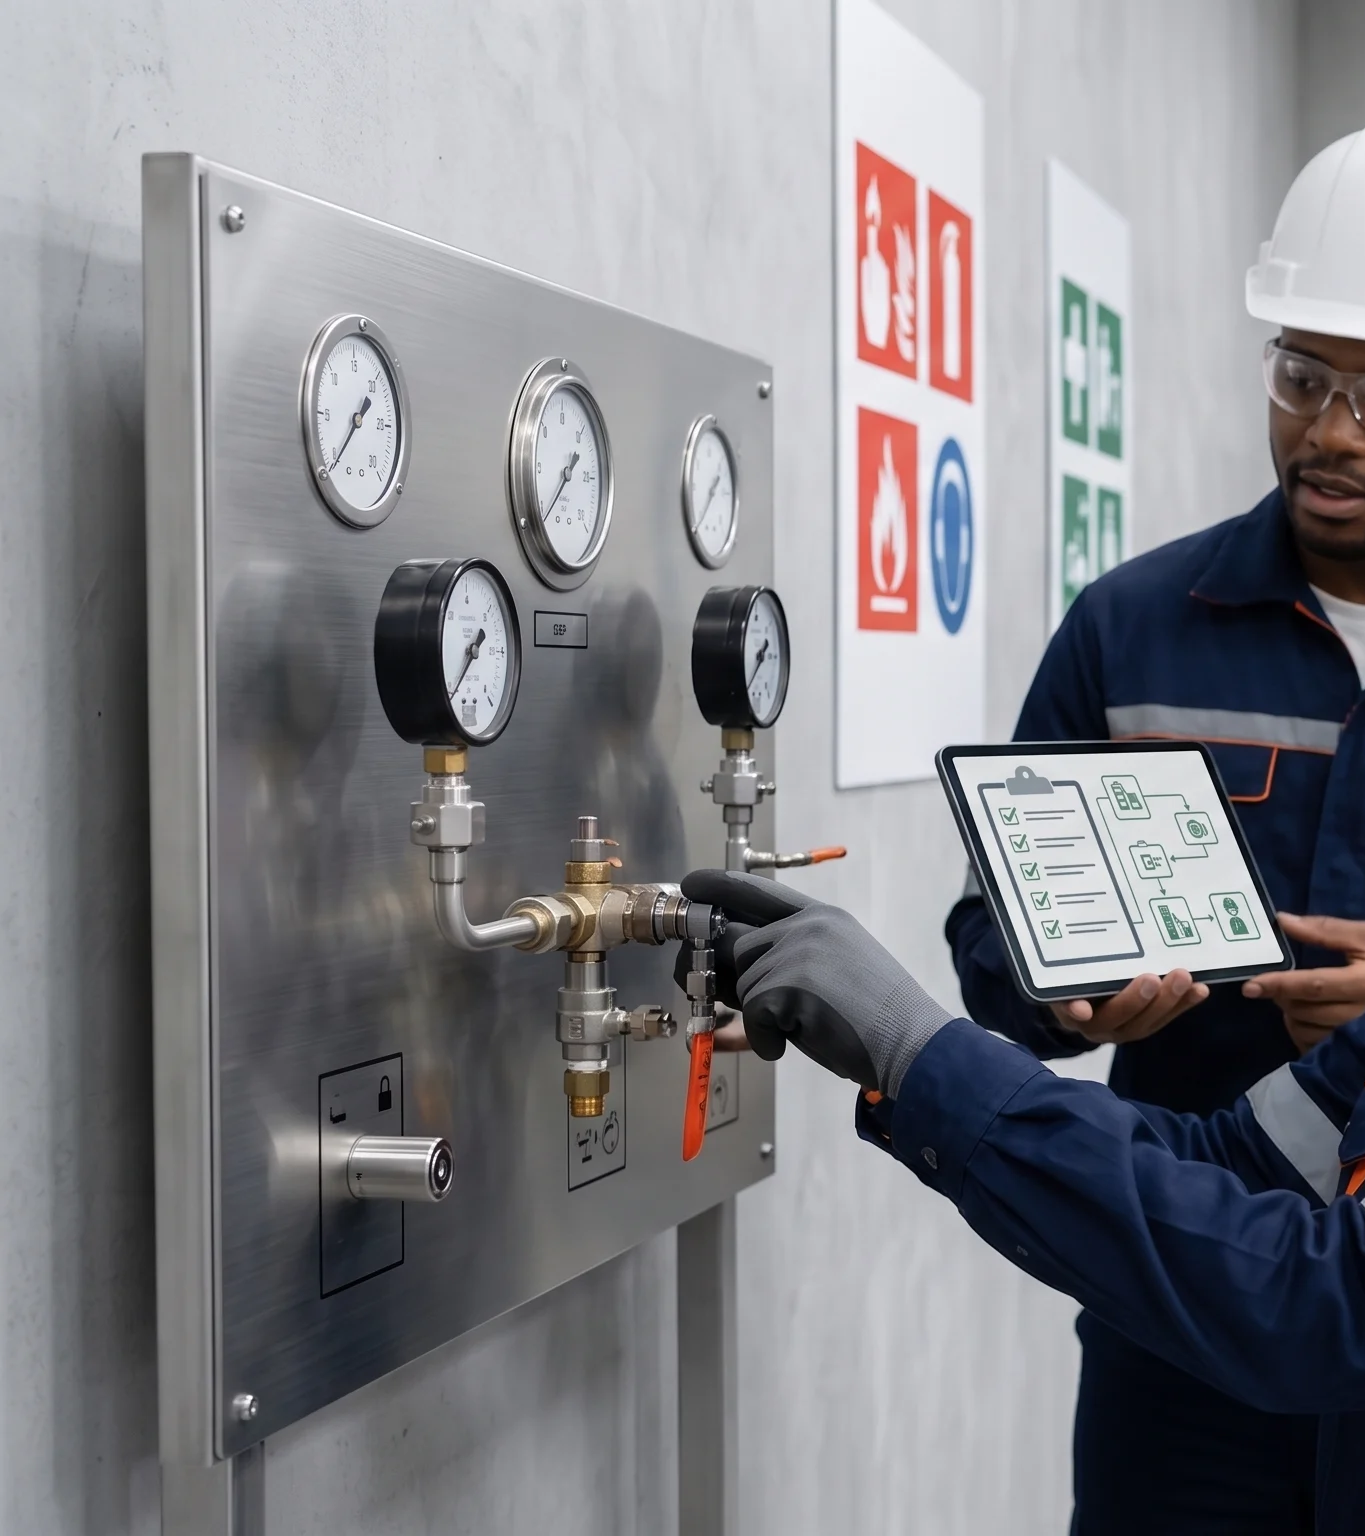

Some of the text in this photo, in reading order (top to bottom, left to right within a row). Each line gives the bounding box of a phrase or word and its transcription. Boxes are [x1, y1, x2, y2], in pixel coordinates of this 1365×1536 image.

[351, 360, 358, 373] 15
[330, 372, 338, 386] 10
[368, 455, 377, 469] 30
